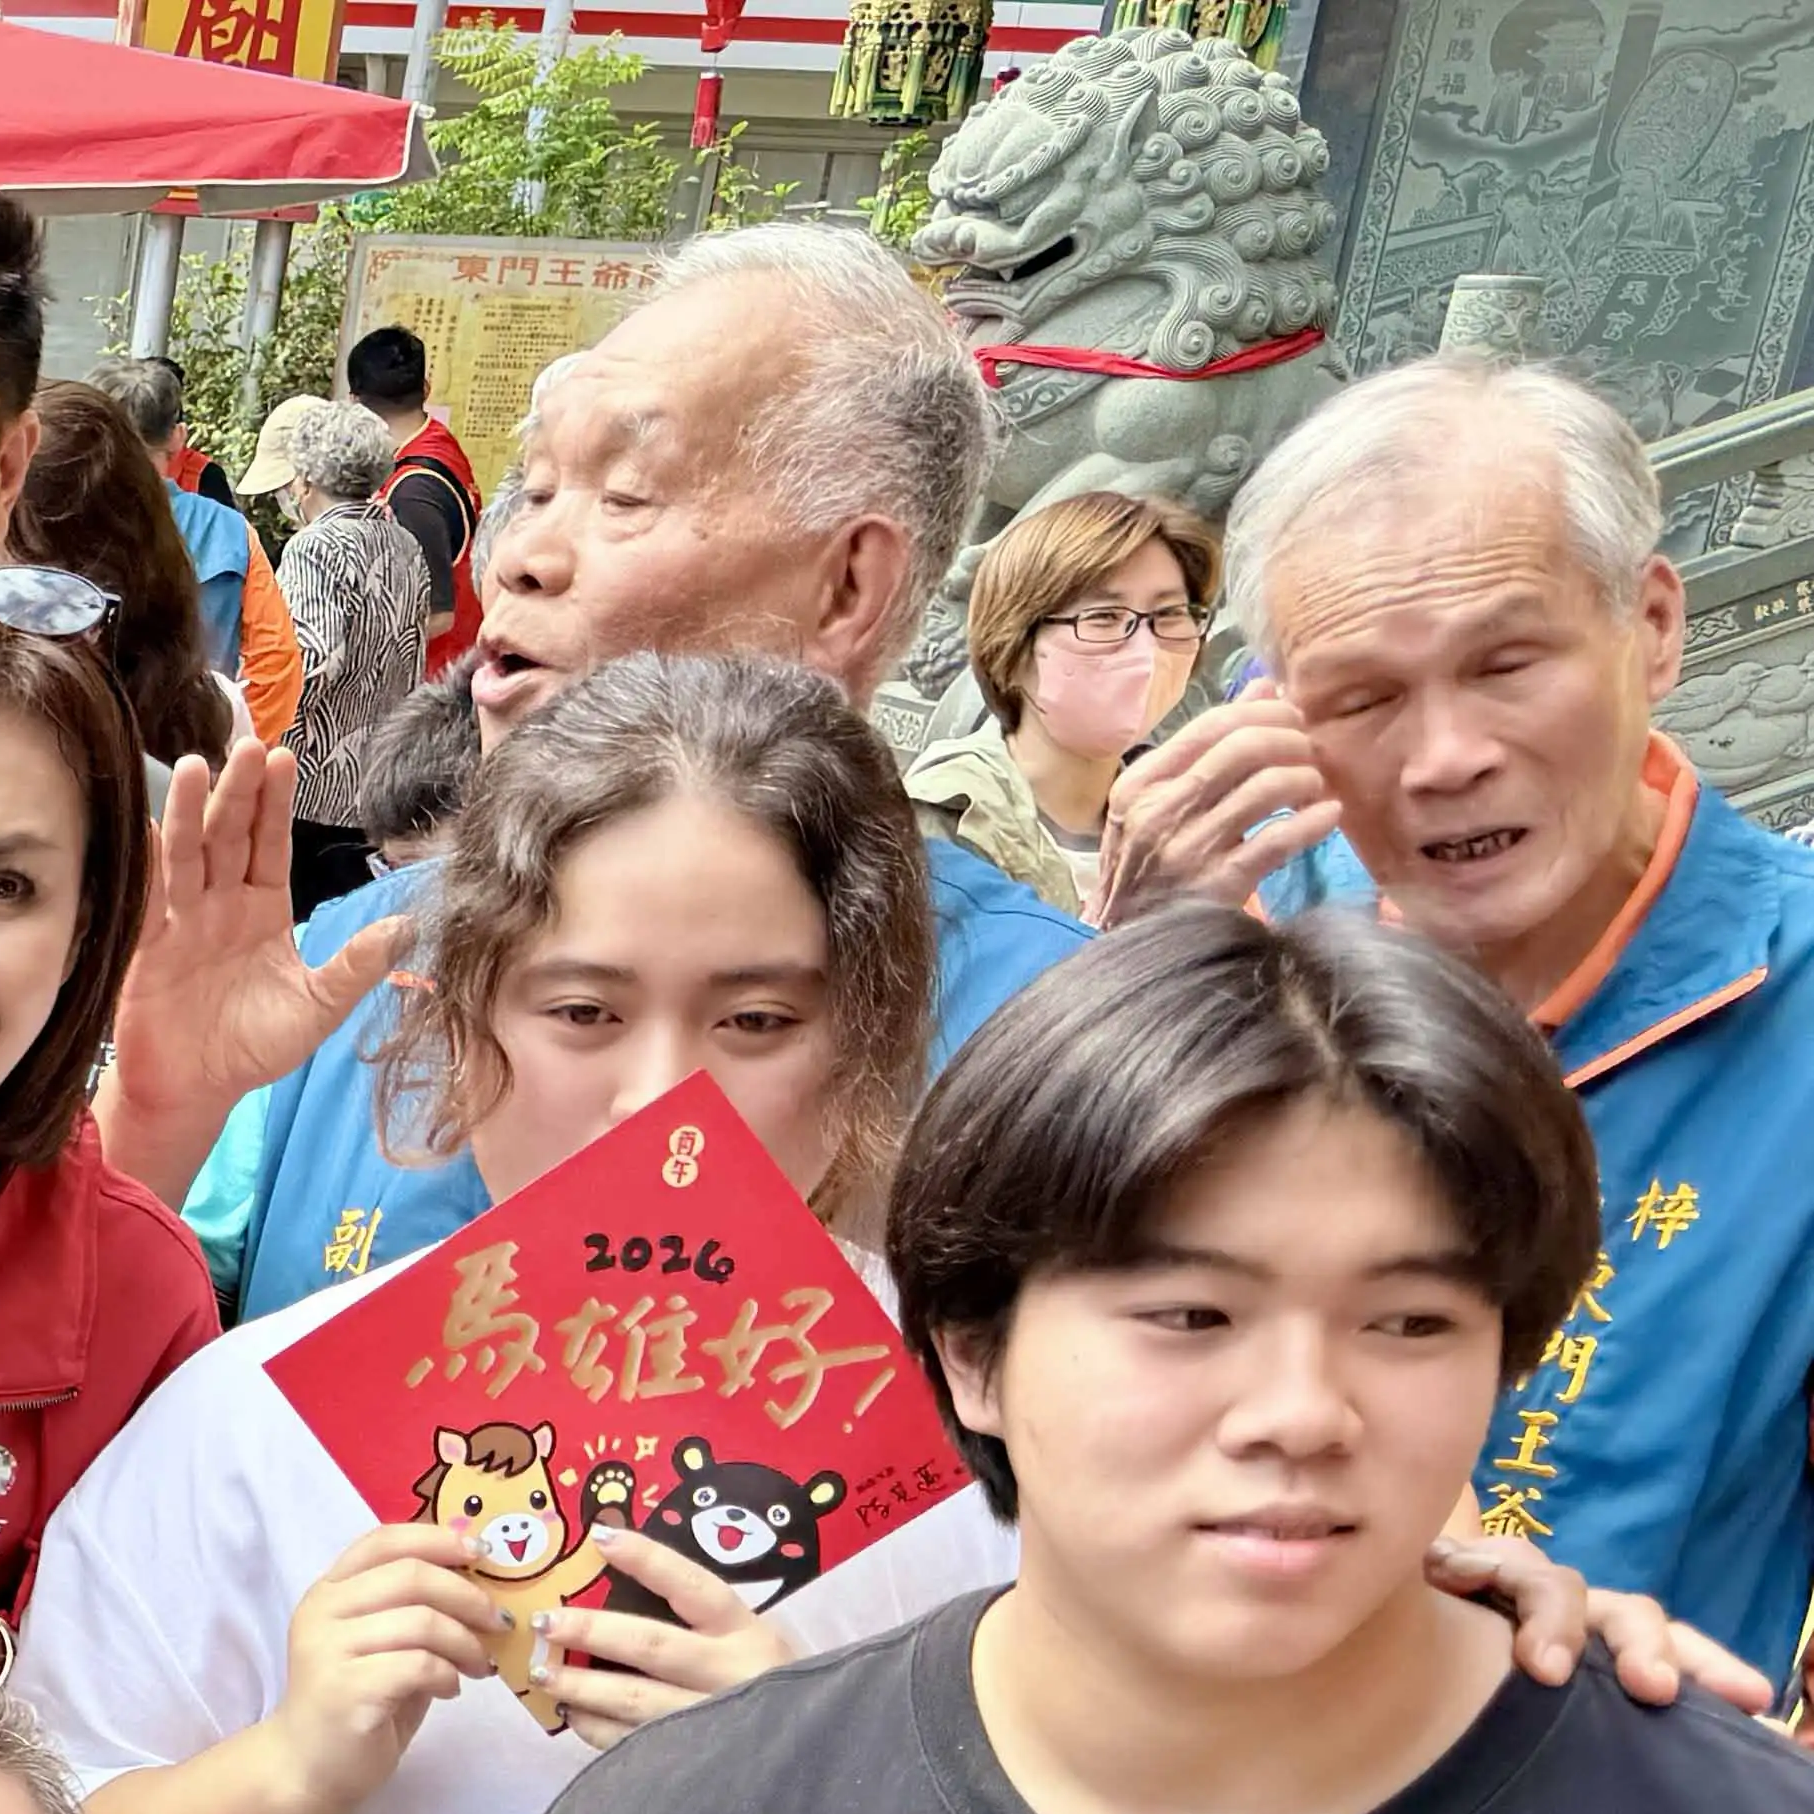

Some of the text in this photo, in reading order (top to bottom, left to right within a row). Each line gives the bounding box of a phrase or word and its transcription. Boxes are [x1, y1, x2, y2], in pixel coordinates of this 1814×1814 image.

[323, 1206, 385, 1276] 副
[1625, 1178, 1701, 1250] 梓
[583, 1232, 736, 1285] 2026
